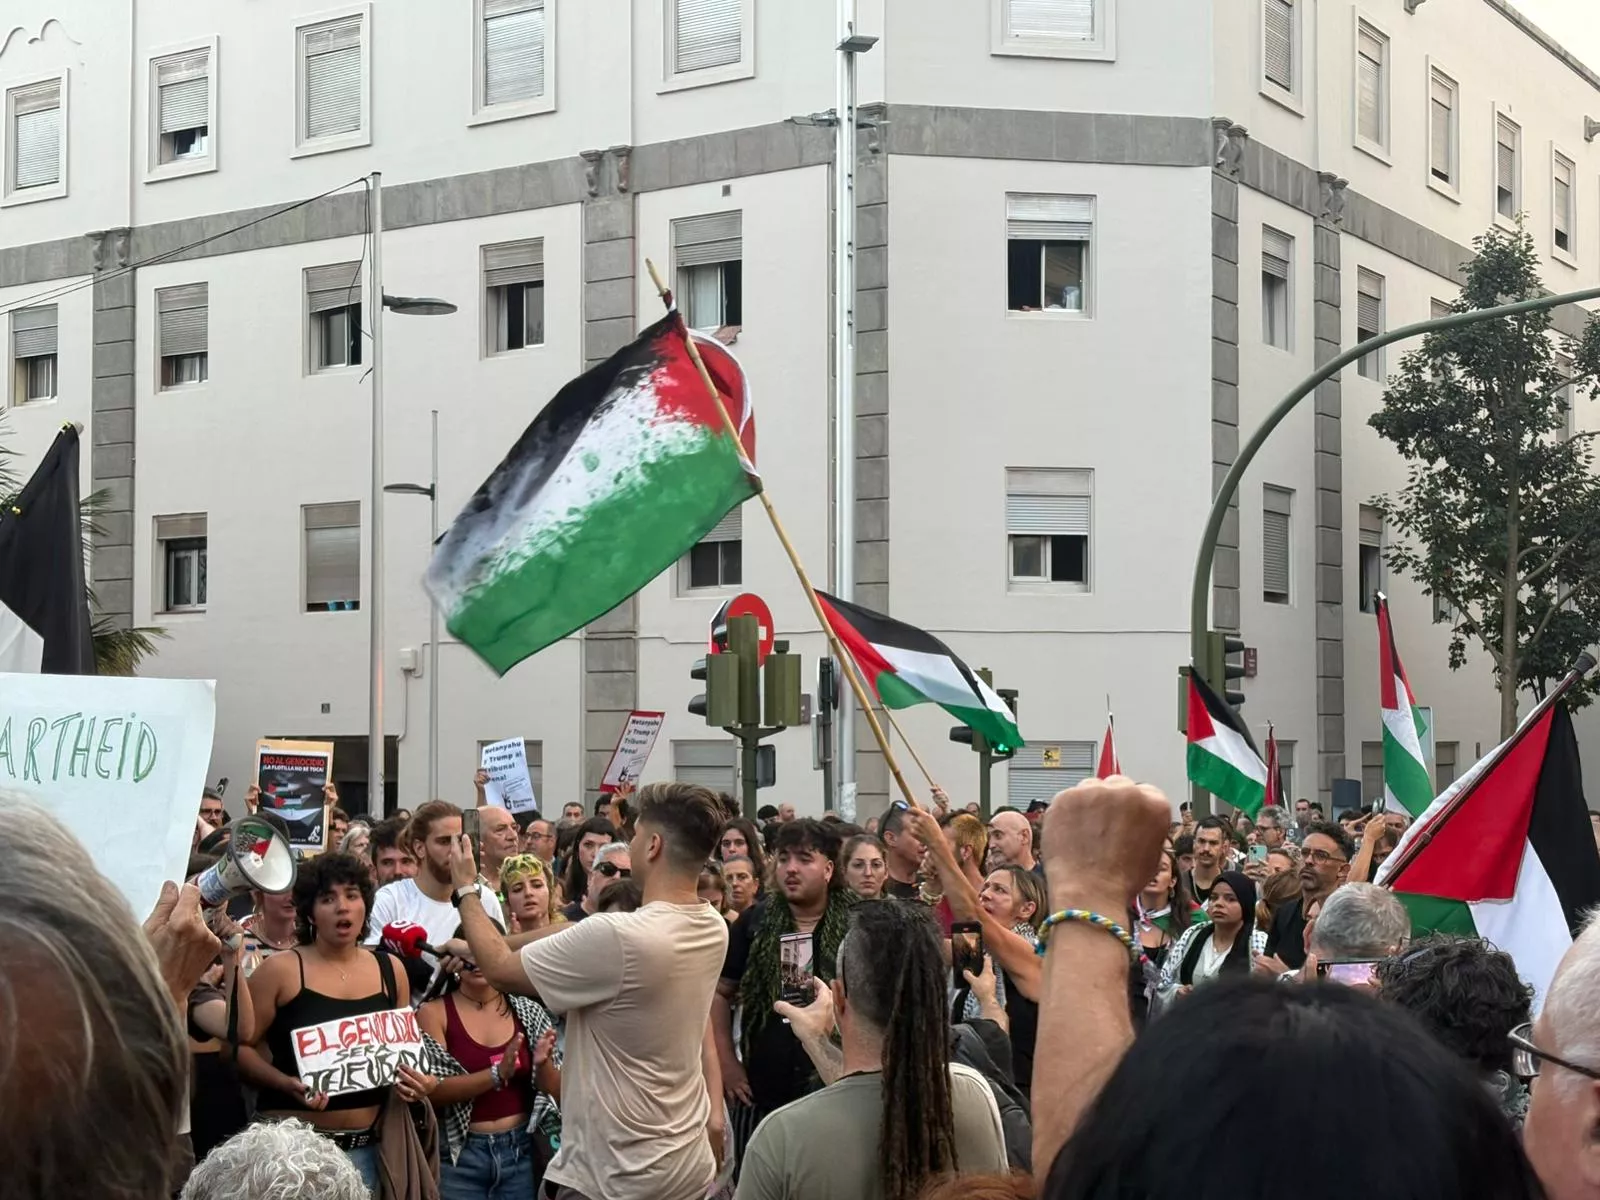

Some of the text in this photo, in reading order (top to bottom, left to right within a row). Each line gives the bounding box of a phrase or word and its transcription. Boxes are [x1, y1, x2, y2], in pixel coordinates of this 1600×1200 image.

[485, 742, 521, 754] Netanyahu
[263, 756, 324, 766] NO AL GENOCIDIO
[489, 753, 513, 762] Trump
[487, 762, 515, 773] ribunal
[296, 1027, 340, 1058] EL
